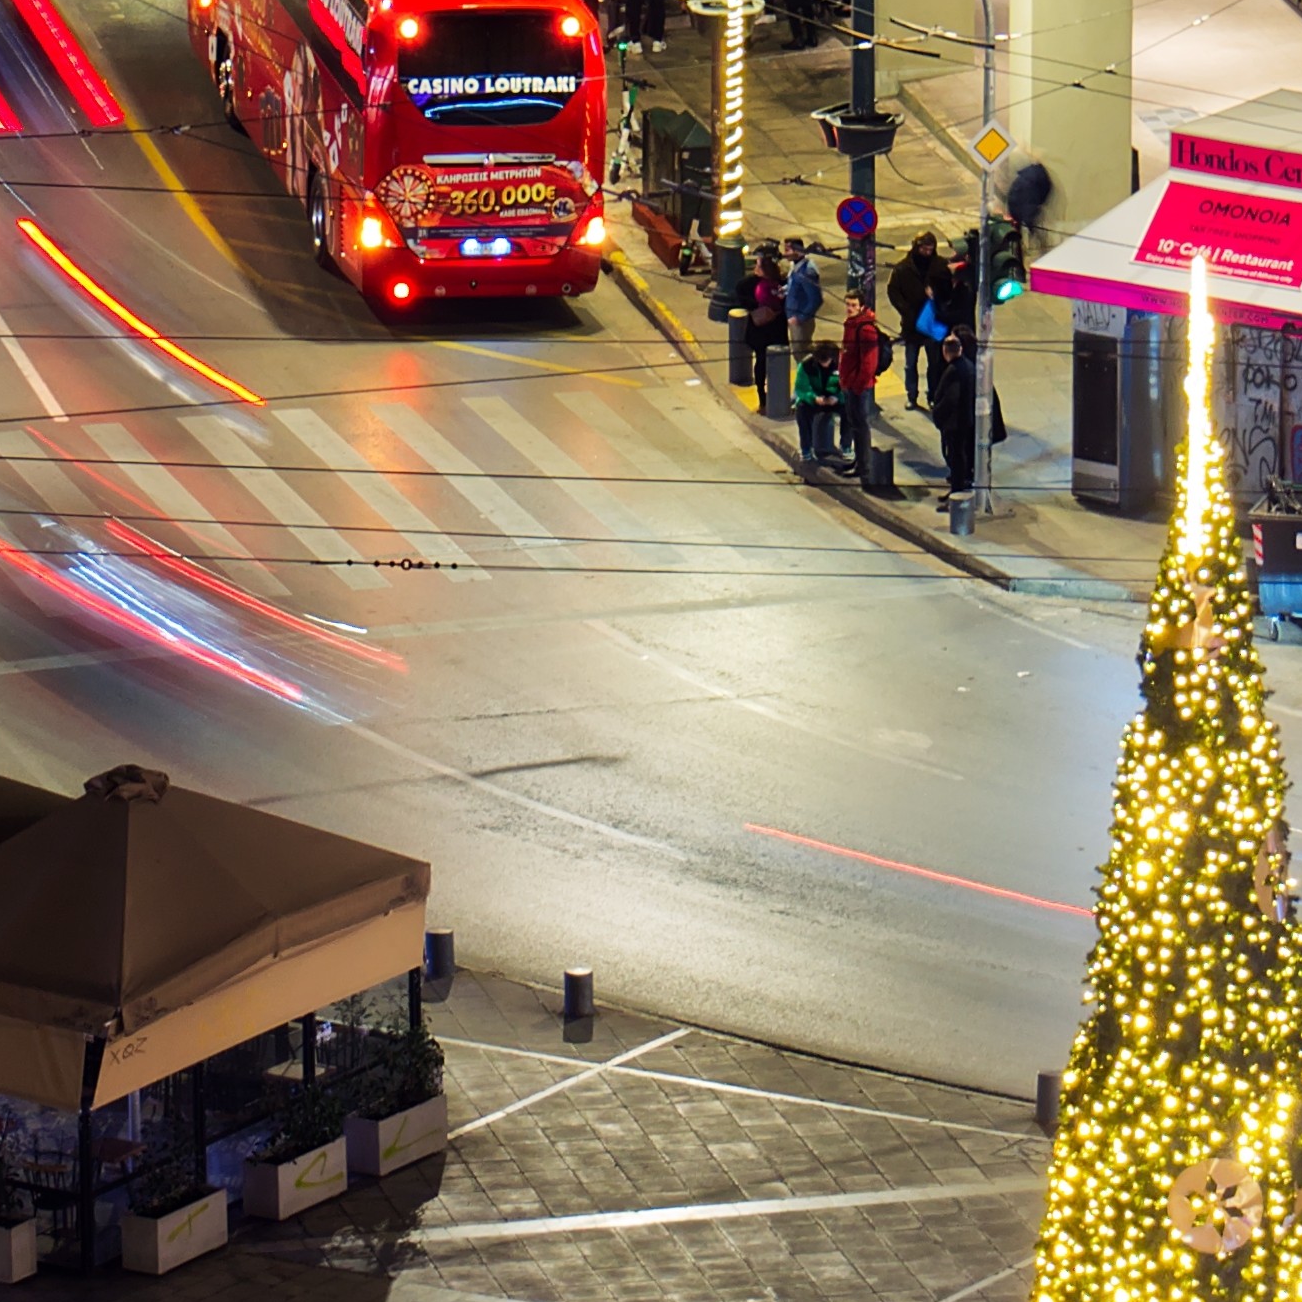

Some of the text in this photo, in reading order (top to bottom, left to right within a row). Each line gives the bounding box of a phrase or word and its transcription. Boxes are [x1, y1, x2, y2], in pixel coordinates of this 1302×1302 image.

[407, 75, 577, 95] CASINO LOUTRAKI
[1176, 138, 1259, 177] Hondos
[1199, 200, 1292, 227] OMONOIA
[1221, 249, 1295, 272] Restaurant
